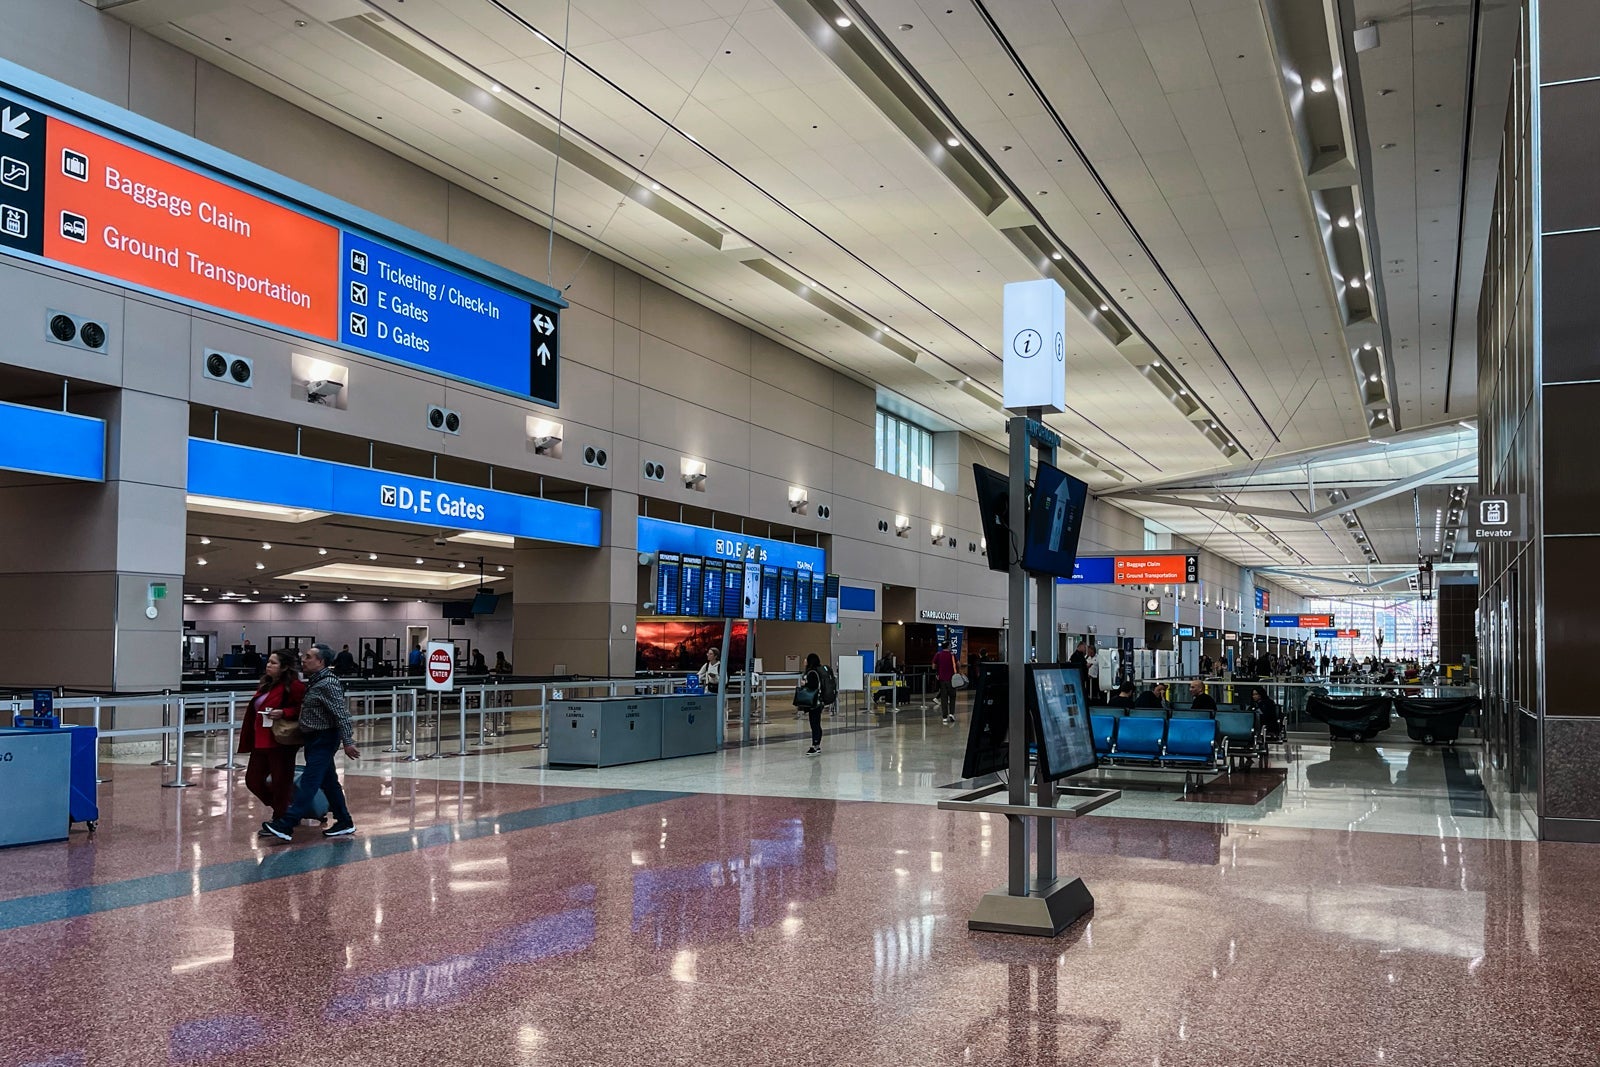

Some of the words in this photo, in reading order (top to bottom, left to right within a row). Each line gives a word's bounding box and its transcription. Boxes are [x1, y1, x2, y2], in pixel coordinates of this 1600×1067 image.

[105, 167, 191, 216] Baggage
[199, 202, 251, 238] Claim
[103, 226, 179, 268] Ground
[187, 252, 311, 309] Transportation
[377, 261, 436, 301] Ticketing
[439, 284, 445, 301] /
[448, 288, 499, 320] Check-In
[378, 290, 387, 309] E
[392, 297, 429, 323] Gates
[377, 322, 388, 339] D
[393, 327, 430, 352] Gates
[399, 486, 432, 514] D,E
[436, 494, 485, 521] Gates
[921, 610, 945, 619] STARBUCKS
[945, 612, 960, 621] COFFEE
